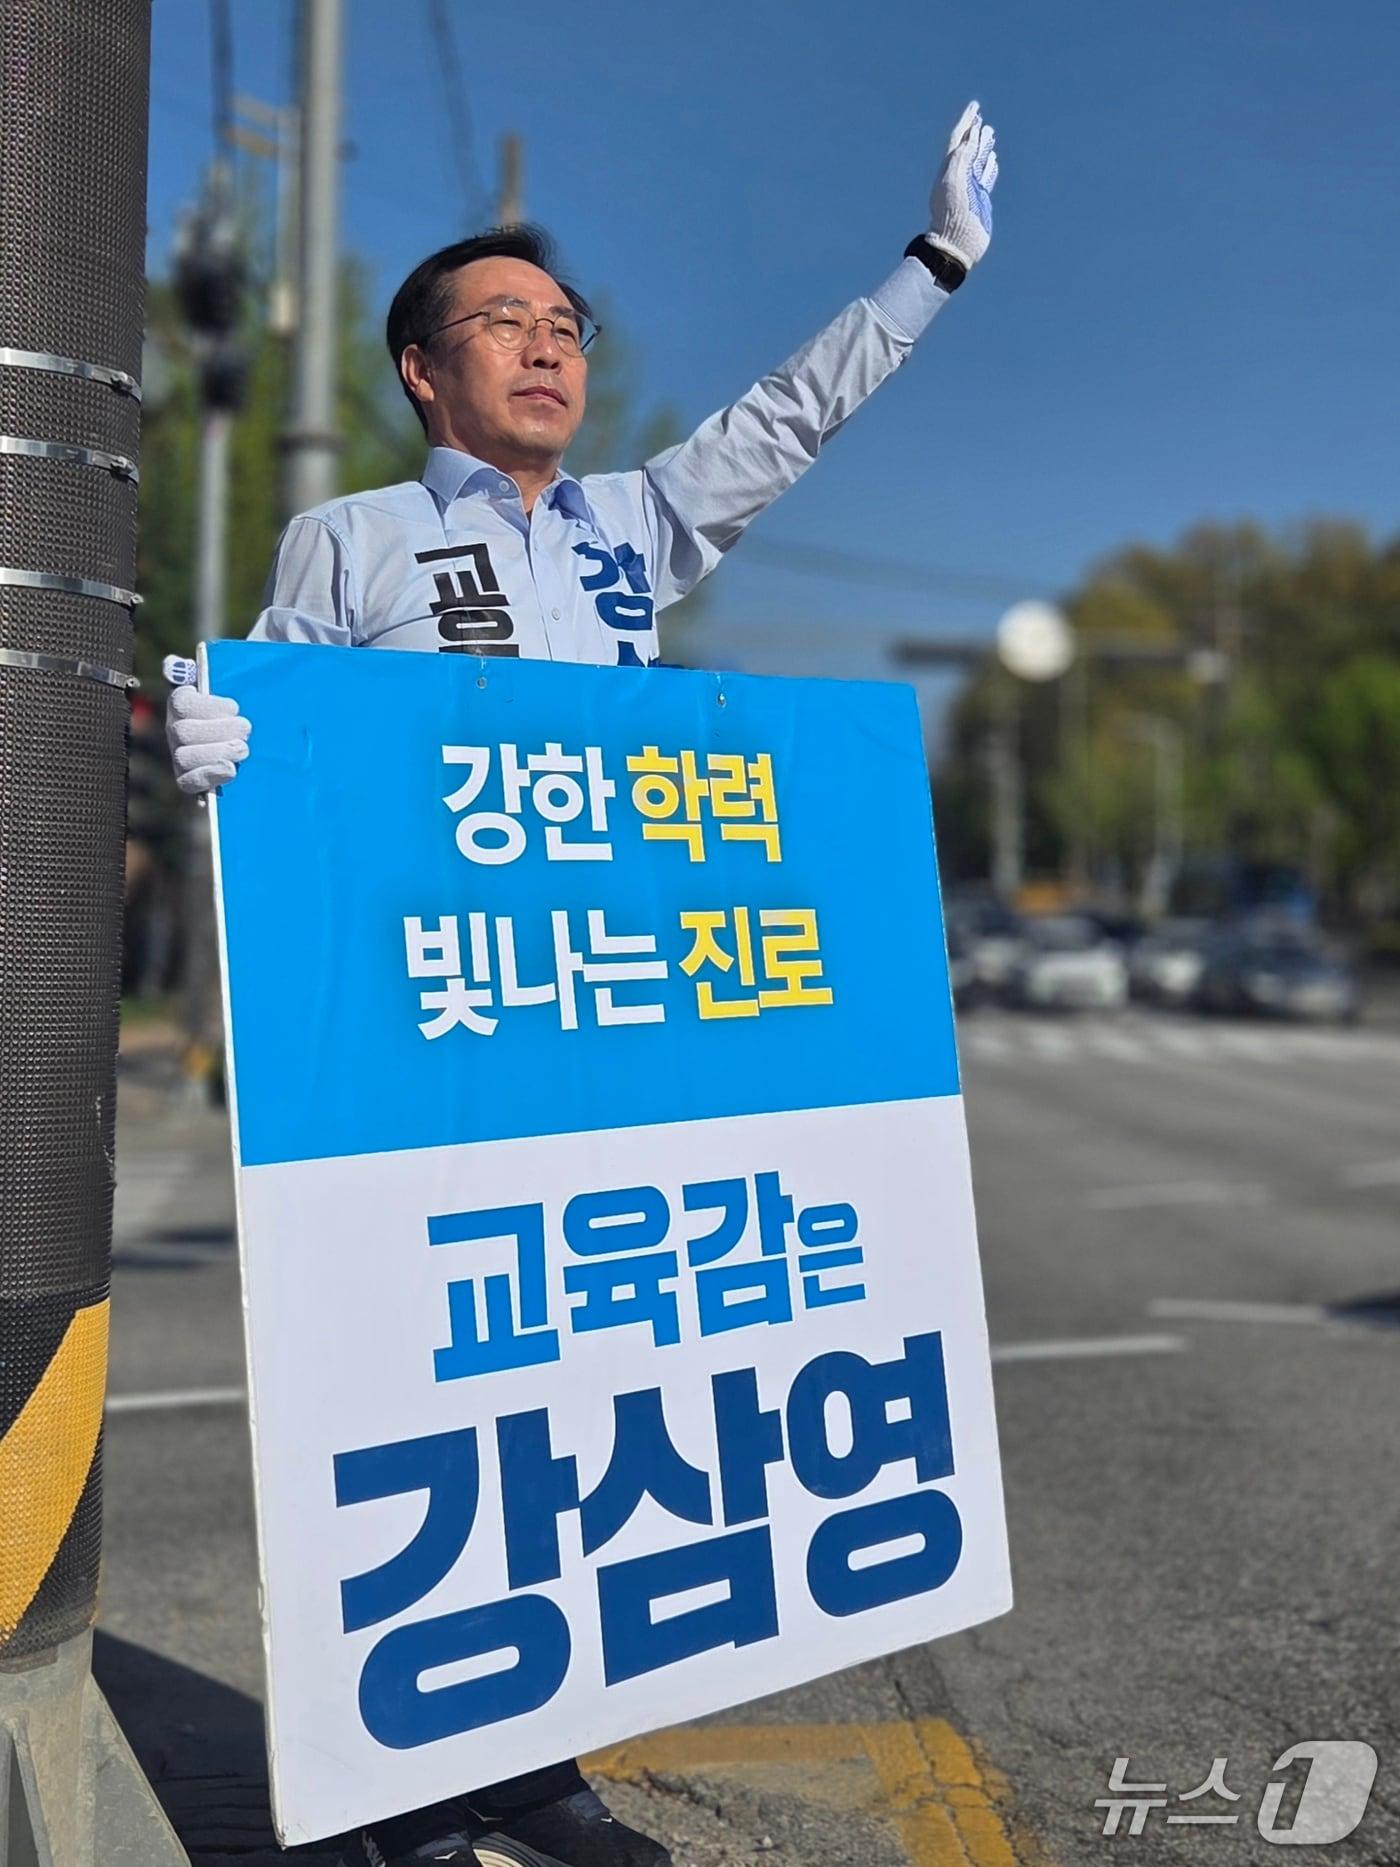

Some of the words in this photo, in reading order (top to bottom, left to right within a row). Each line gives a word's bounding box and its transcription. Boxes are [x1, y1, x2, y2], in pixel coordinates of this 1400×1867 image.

[441, 742, 616, 865] 강한
[626, 745, 782, 862] 학력
[403, 908, 669, 1040] 빛나는
[678, 906, 834, 1020] 진로
[427, 1170, 867, 1383] 교육감은
[333, 1330, 963, 1750] 강삼영
